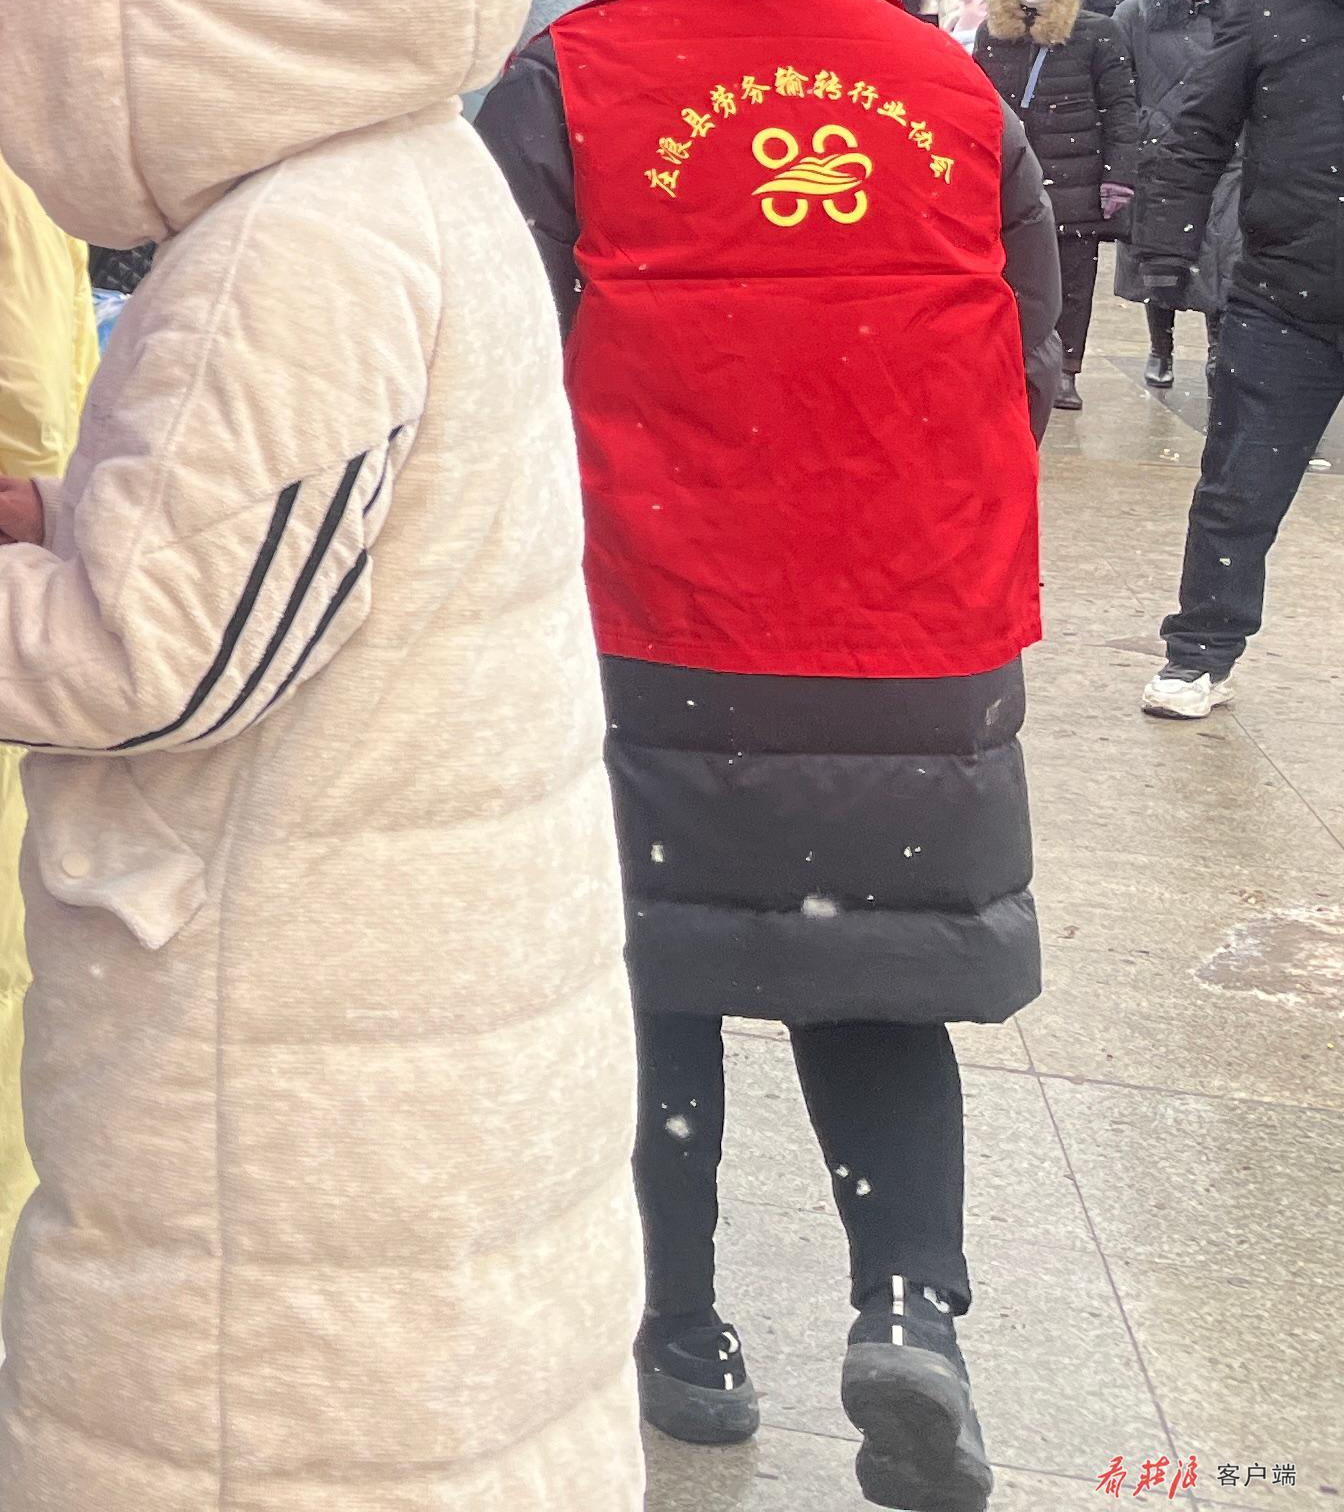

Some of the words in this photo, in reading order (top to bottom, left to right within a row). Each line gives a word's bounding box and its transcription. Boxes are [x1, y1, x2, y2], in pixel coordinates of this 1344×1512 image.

[644, 65, 954, 200] 庄浪县劳务输转行业协会
